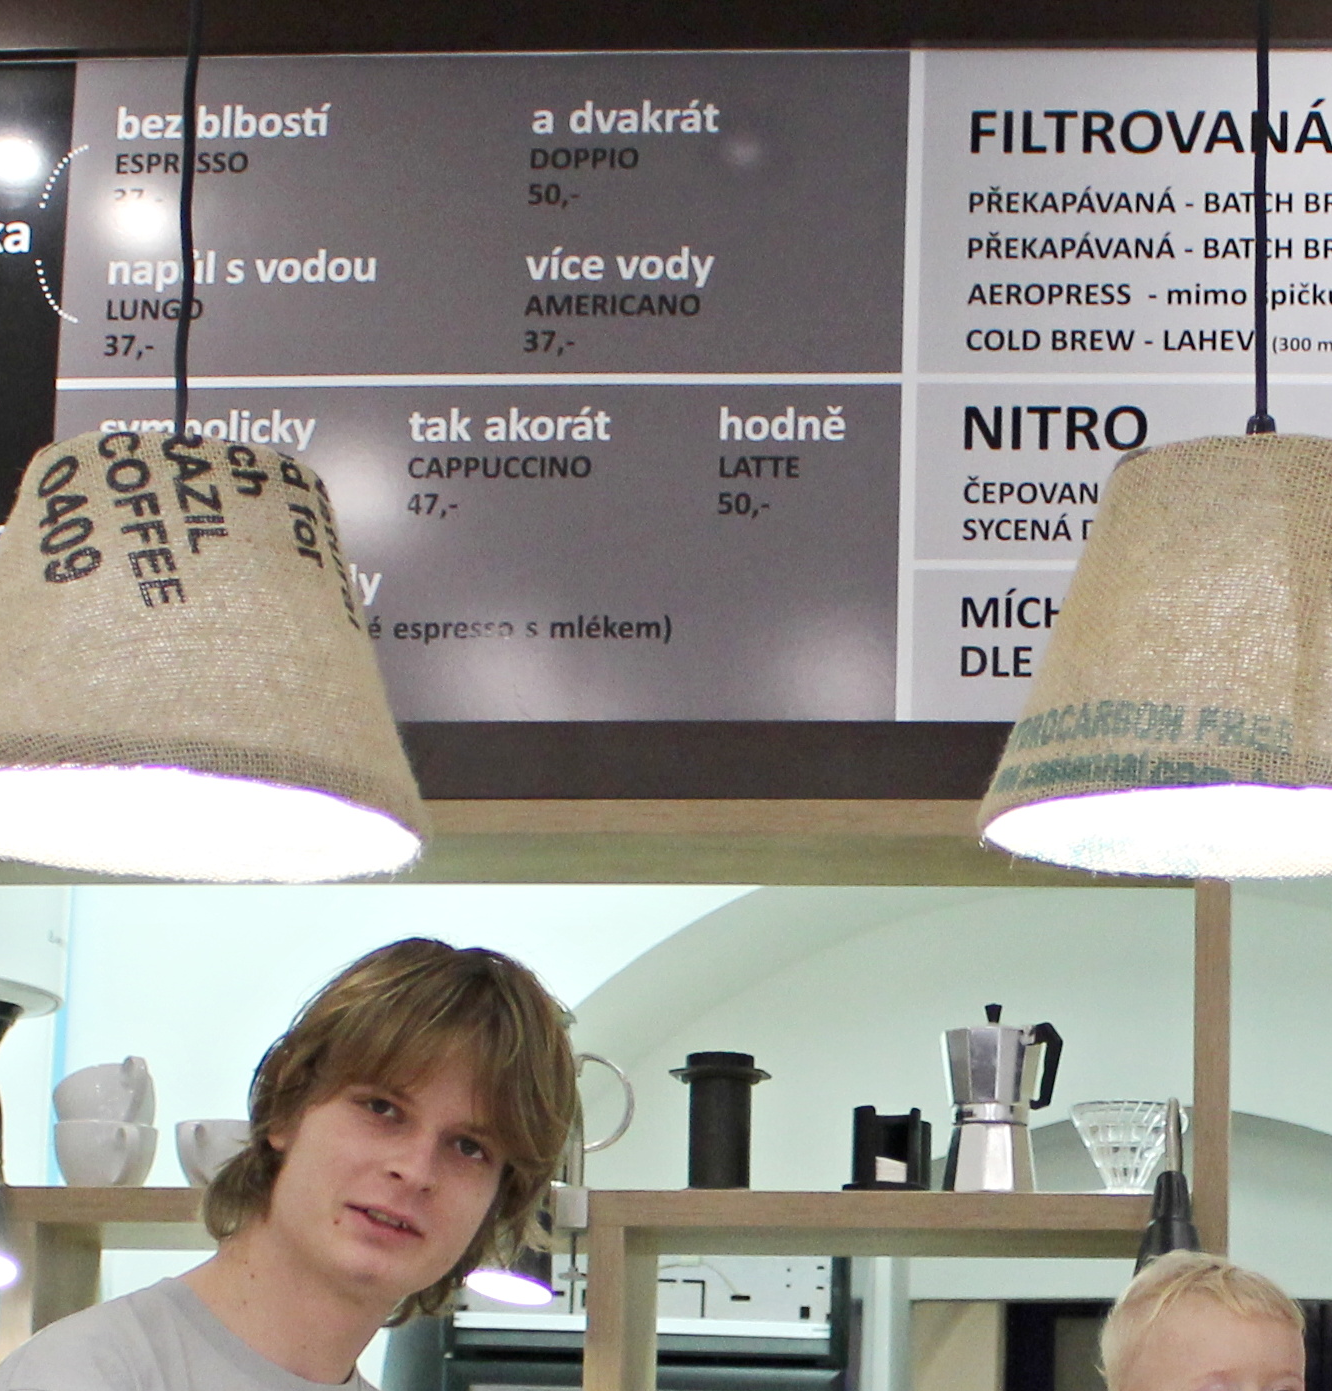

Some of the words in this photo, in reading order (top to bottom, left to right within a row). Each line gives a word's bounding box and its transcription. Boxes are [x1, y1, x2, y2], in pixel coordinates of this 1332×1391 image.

[116, 105, 184, 140] bez
[197, 102, 331, 138] blbostí
[533, 107, 555, 134] a
[569, 99, 720, 135] dvakrát
[115, 151, 249, 175] ESPRSSO
[529, 146, 640, 171] DOPPIO
[527, 183, 581, 210] 50,-
[967, 187, 1176, 215] PŘEKAPÁVANÁ
[966, 232, 1176, 260] PŘEKAPÁVANÁ
[225, 259, 245, 284] s
[255, 250, 378, 284] vodou
[526, 245, 606, 283] více
[615, 245, 715, 291] vody
[524, 293, 702, 319] AMERICANO
[966, 282, 1132, 306] AEROPRESS
[1166, 281, 1248, 306] mimo
[105, 298, 204, 322] LUNGO
[103, 334, 155, 360] 37,-
[524, 329, 576, 357] 37,-
[965, 328, 1042, 352] COLD
[1050, 328, 1136, 352] BREW
[1271, 336, 1312, 355] (300
[410, 406, 470, 442] tak
[484, 406, 611, 442] akorát
[719, 404, 846, 442] hodně
[963, 405, 1150, 452] NITRO
[407, 454, 593, 479] CAPPUCCINO
[718, 454, 801, 478] LATTE
[963, 475, 1099, 506] ČEPOVAN
[97, 431, 187, 608] COFFEE
[407, 493, 460, 519] 47,-
[716, 493, 772, 518] 50,-
[962, 513, 1072, 543] SYCENÁ
[961, 590, 1061, 629] MÍCH
[393, 620, 514, 645] espresso
[525, 623, 539, 638] s
[549, 613, 674, 648] mlékem)
[959, 645, 1033, 678] DLE
